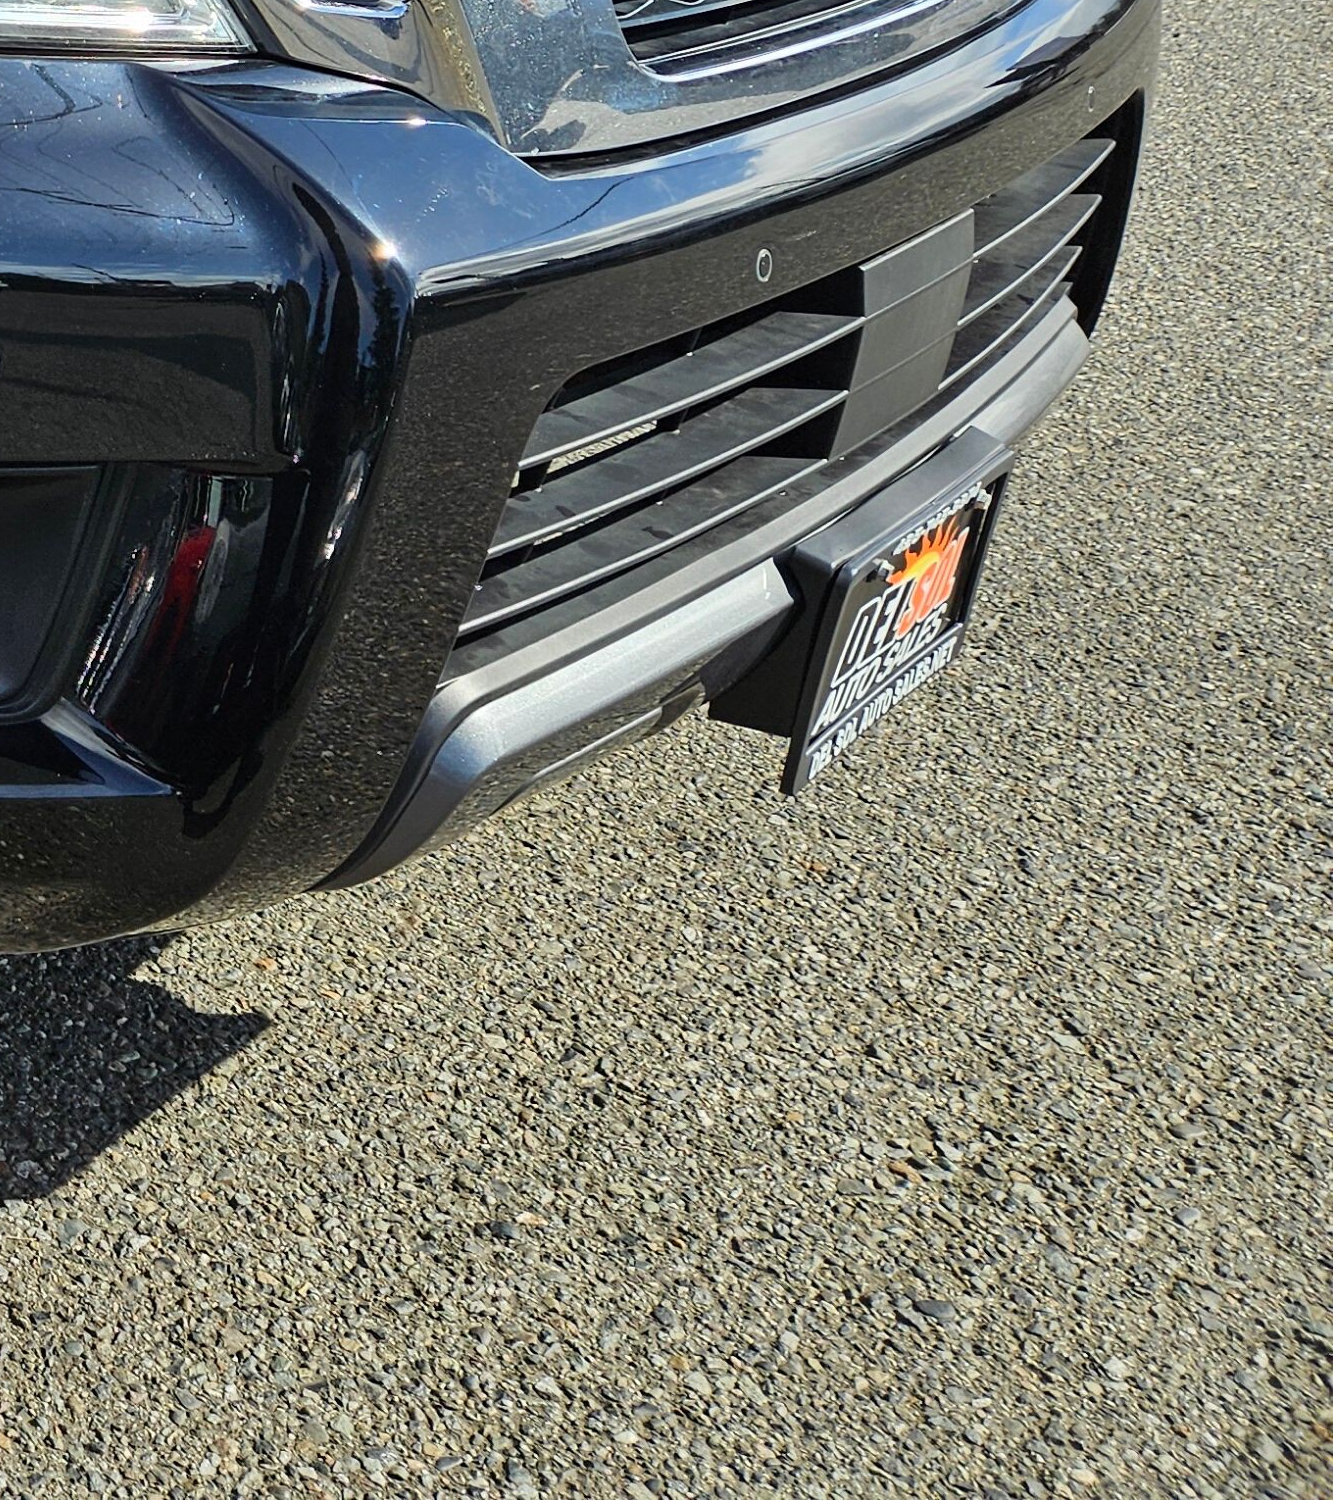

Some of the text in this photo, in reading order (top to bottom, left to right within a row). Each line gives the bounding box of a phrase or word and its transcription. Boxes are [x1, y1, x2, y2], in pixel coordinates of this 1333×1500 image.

[895, 527, 971, 640] SOL
[811, 602, 949, 736] AUTO SALES
